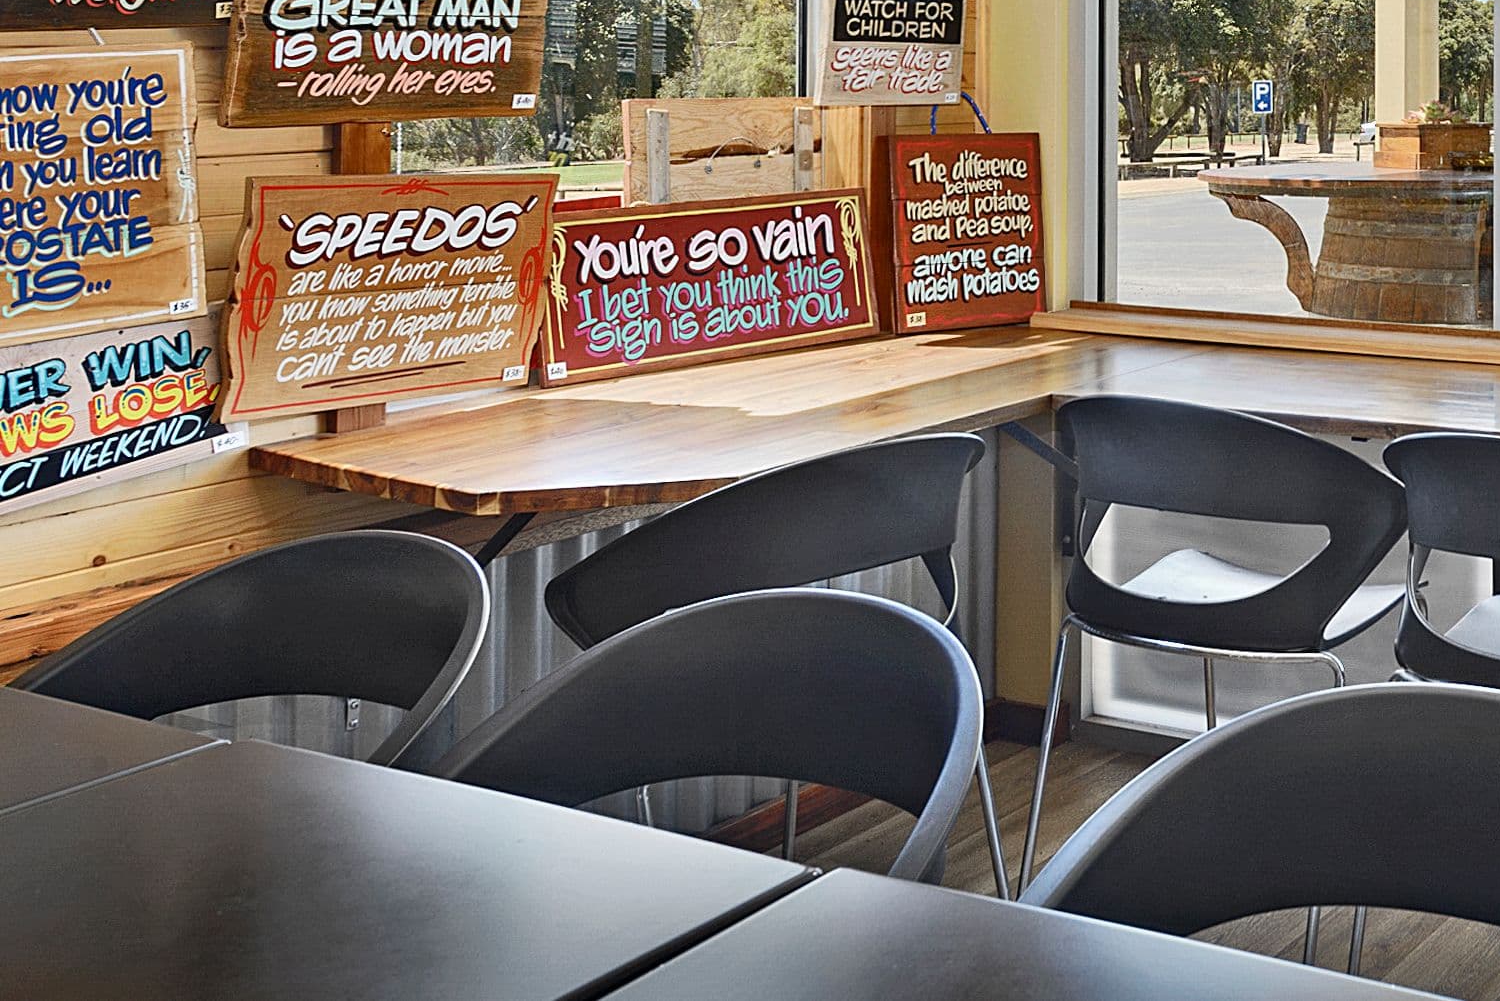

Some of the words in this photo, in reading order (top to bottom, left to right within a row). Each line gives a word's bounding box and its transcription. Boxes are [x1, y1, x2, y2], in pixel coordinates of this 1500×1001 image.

[846, 17, 946, 38] CHILDREN
[915, 2, 953, 21] FOR
[273, 30, 315, 68] is
[328, 33, 363, 62] a
[374, 33, 511, 62] woman
[69, 67, 167, 110] you're
[1256, 83, 1269, 100] P
[23, 157, 77, 198] you
[82, 148, 161, 182] learn
[908, 156, 946, 184] The
[951, 150, 1027, 181] difference
[575, 225, 678, 283] You're
[687, 228, 746, 270] so
[752, 207, 833, 257] vain
[288, 270, 325, 296] are
[329, 261, 359, 287] like
[365, 264, 382, 285] a
[386, 256, 447, 282] horror
[59, 412, 211, 479] WEEKEND!
